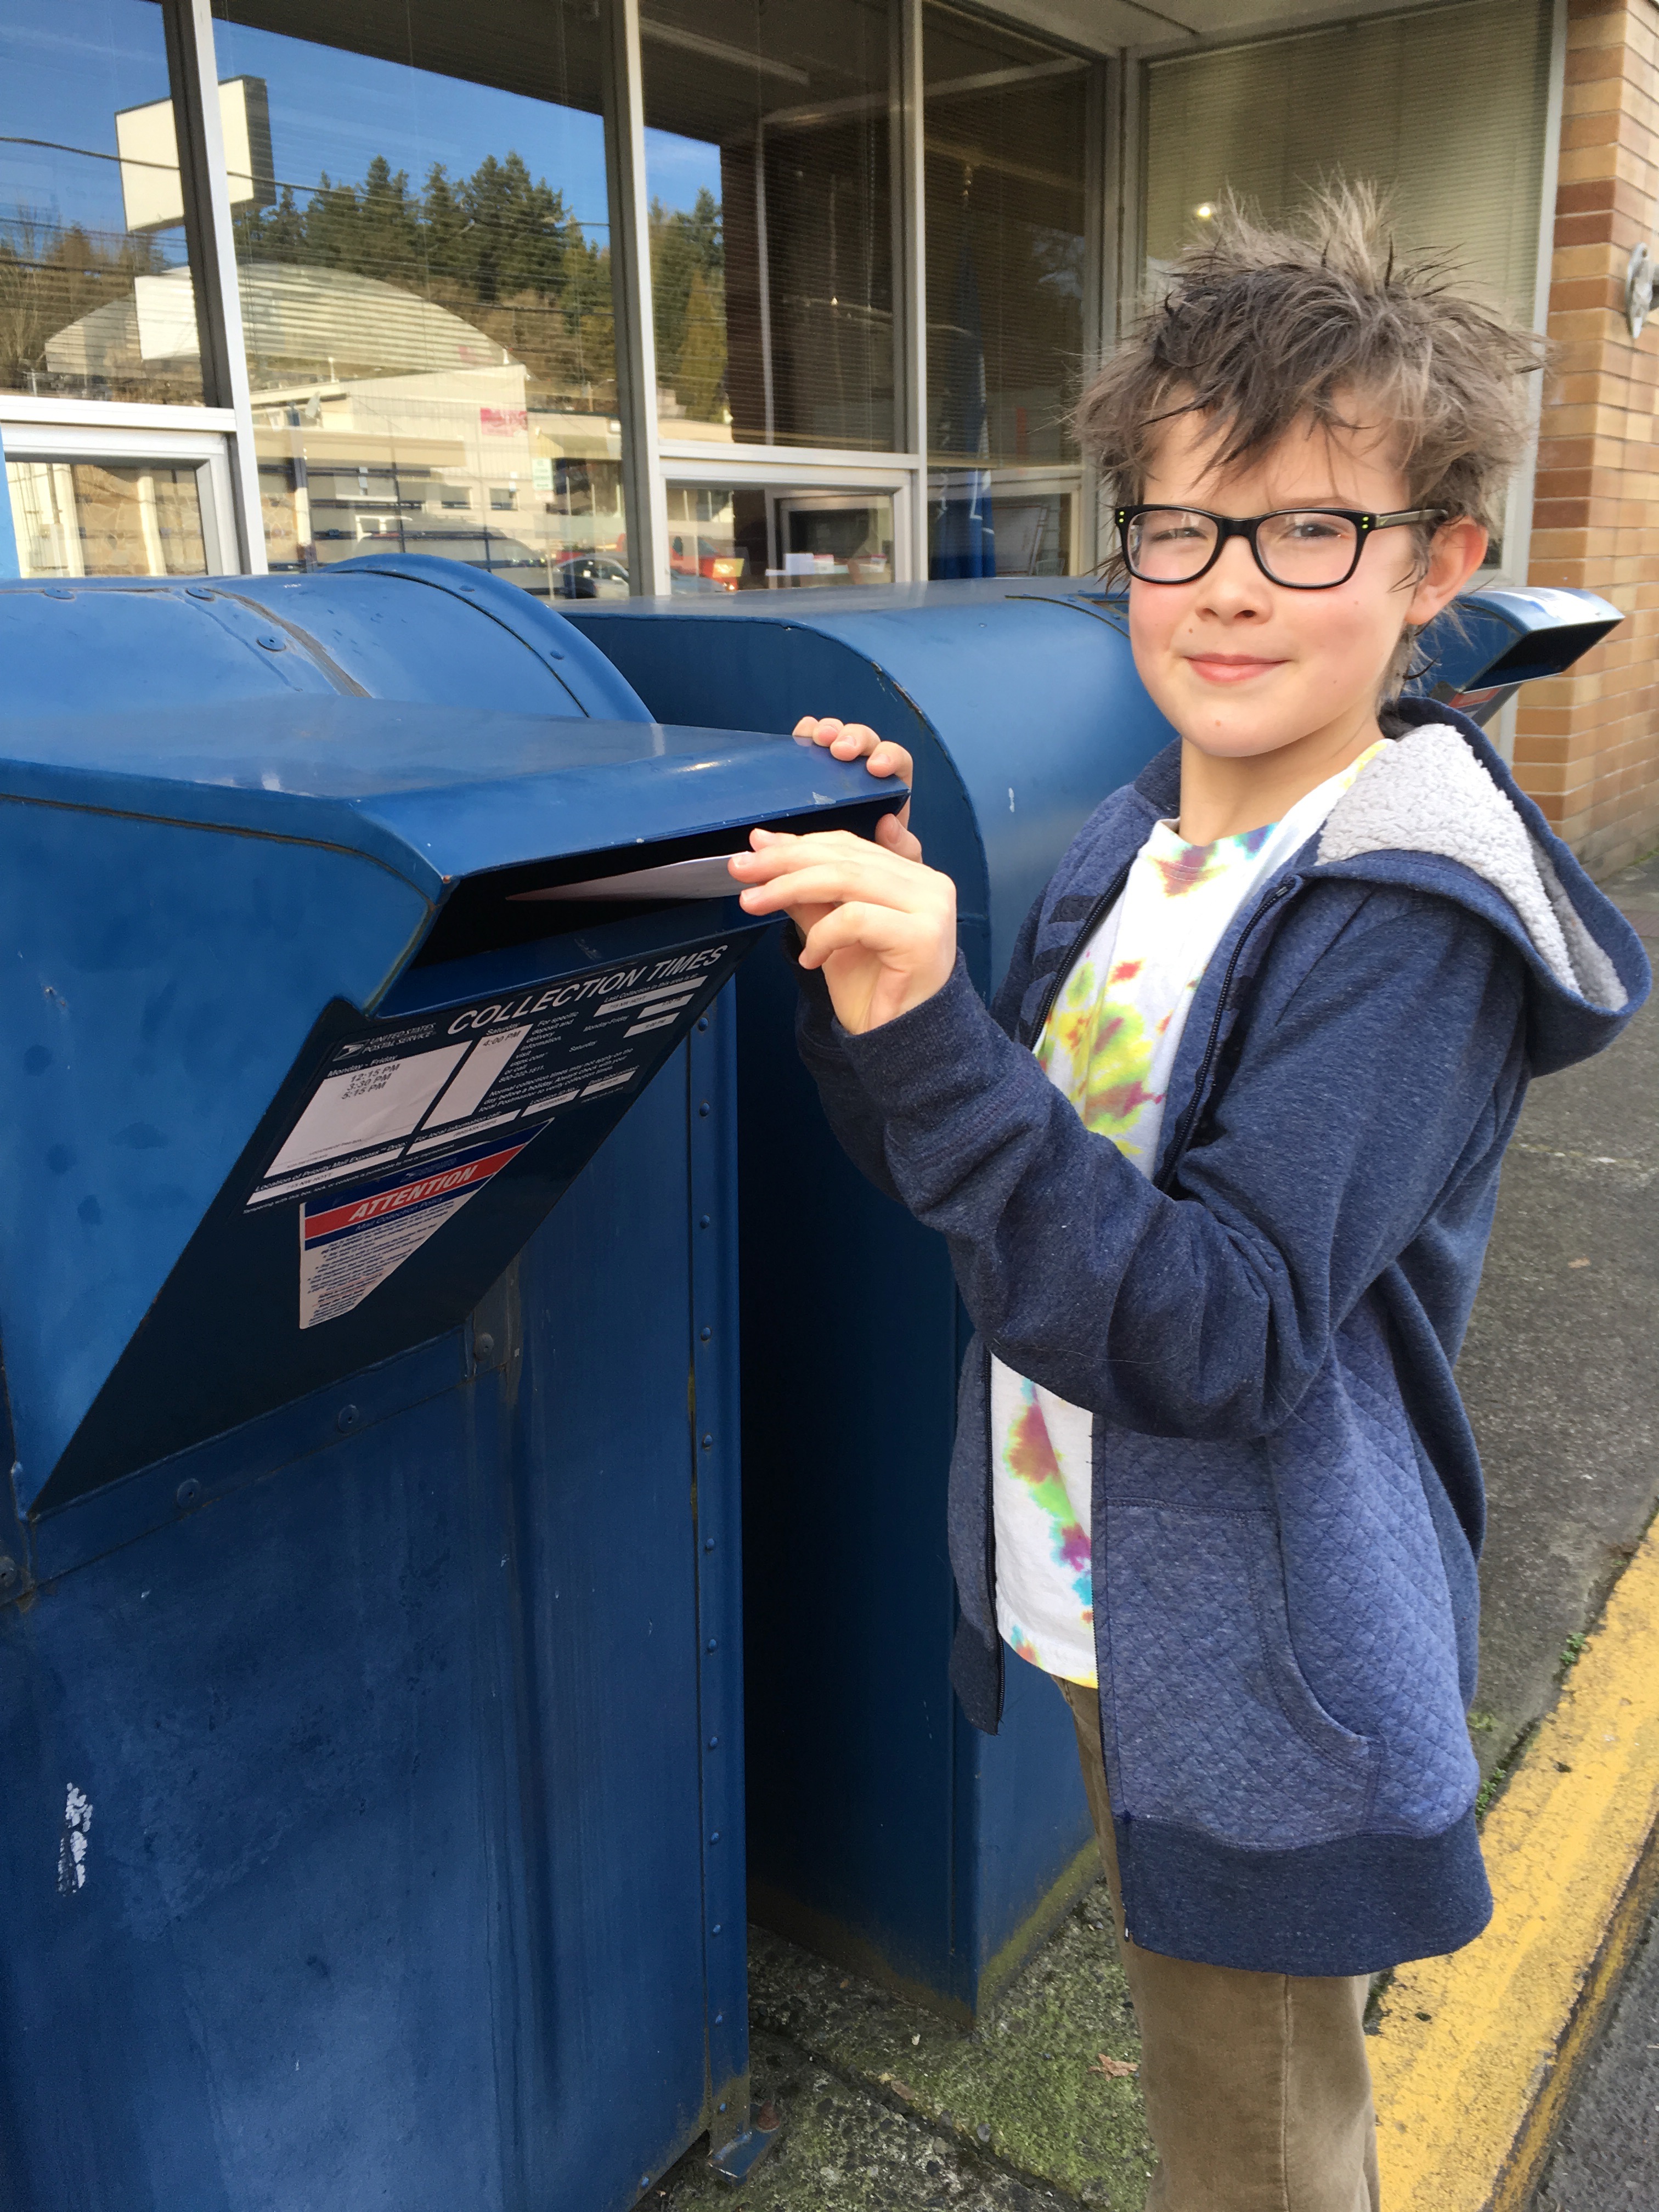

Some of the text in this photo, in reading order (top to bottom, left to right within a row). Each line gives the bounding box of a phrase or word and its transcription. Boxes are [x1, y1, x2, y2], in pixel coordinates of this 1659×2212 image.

[449, 945, 727, 1034] COLLECTION TIMES
[603, 995, 619, 1003] Last
[619, 986, 651, 998] Collection
[532, 1018, 574, 1035] deposit and
[551, 1012, 579, 1023] specific
[370, 1023, 436, 1044] UNITED STATES
[483, 1030, 521, 1046] 4:00 PM
[486, 1023, 520, 1035] Saturday
[526, 1031, 555, 1043] delivery
[362, 1040, 395, 1053] POSTAL
[516, 1050, 532, 1059] visit
[569, 1040, 597, 1052] Saturday
[328, 1064, 363, 1077] Monday
[370, 1055, 398, 1066] Friday
[351, 1063, 400, 1082] 12:15 PM
[513, 1064, 528, 1073] call
[347, 1073, 392, 1091] 3:30 PM
[489, 1085, 516, 1097] Normal
[516, 1075, 549, 1089] collection
[549, 1069, 568, 1078] times
[595, 1054, 613, 1064] apply
[498, 1090, 522, 1100] before
[554, 1071, 578, 1083] Always
[578, 1065, 597, 1075] check
[599, 1060, 612, 1068] with
[611, 1056, 627, 1065] your
[341, 1081, 387, 1099] 5:15 PM
[478, 1102, 497, 1113] local
[497, 1091, 537, 1107] Postmaster
[545, 1082, 564, 1091] verify
[565, 1071, 595, 1085] collection
[529, 1093, 557, 1105] Location
[428, 1128, 447, 1138] local
[447, 1116, 487, 1132] information
[255, 1177, 291, 1192] Location
[302, 1165, 331, 1177] Priority
[332, 1159, 349, 1170] Mail
[349, 1166, 477, 1221] ATTENTION
[355, 1197, 445, 1231] Mail Collection Policy
